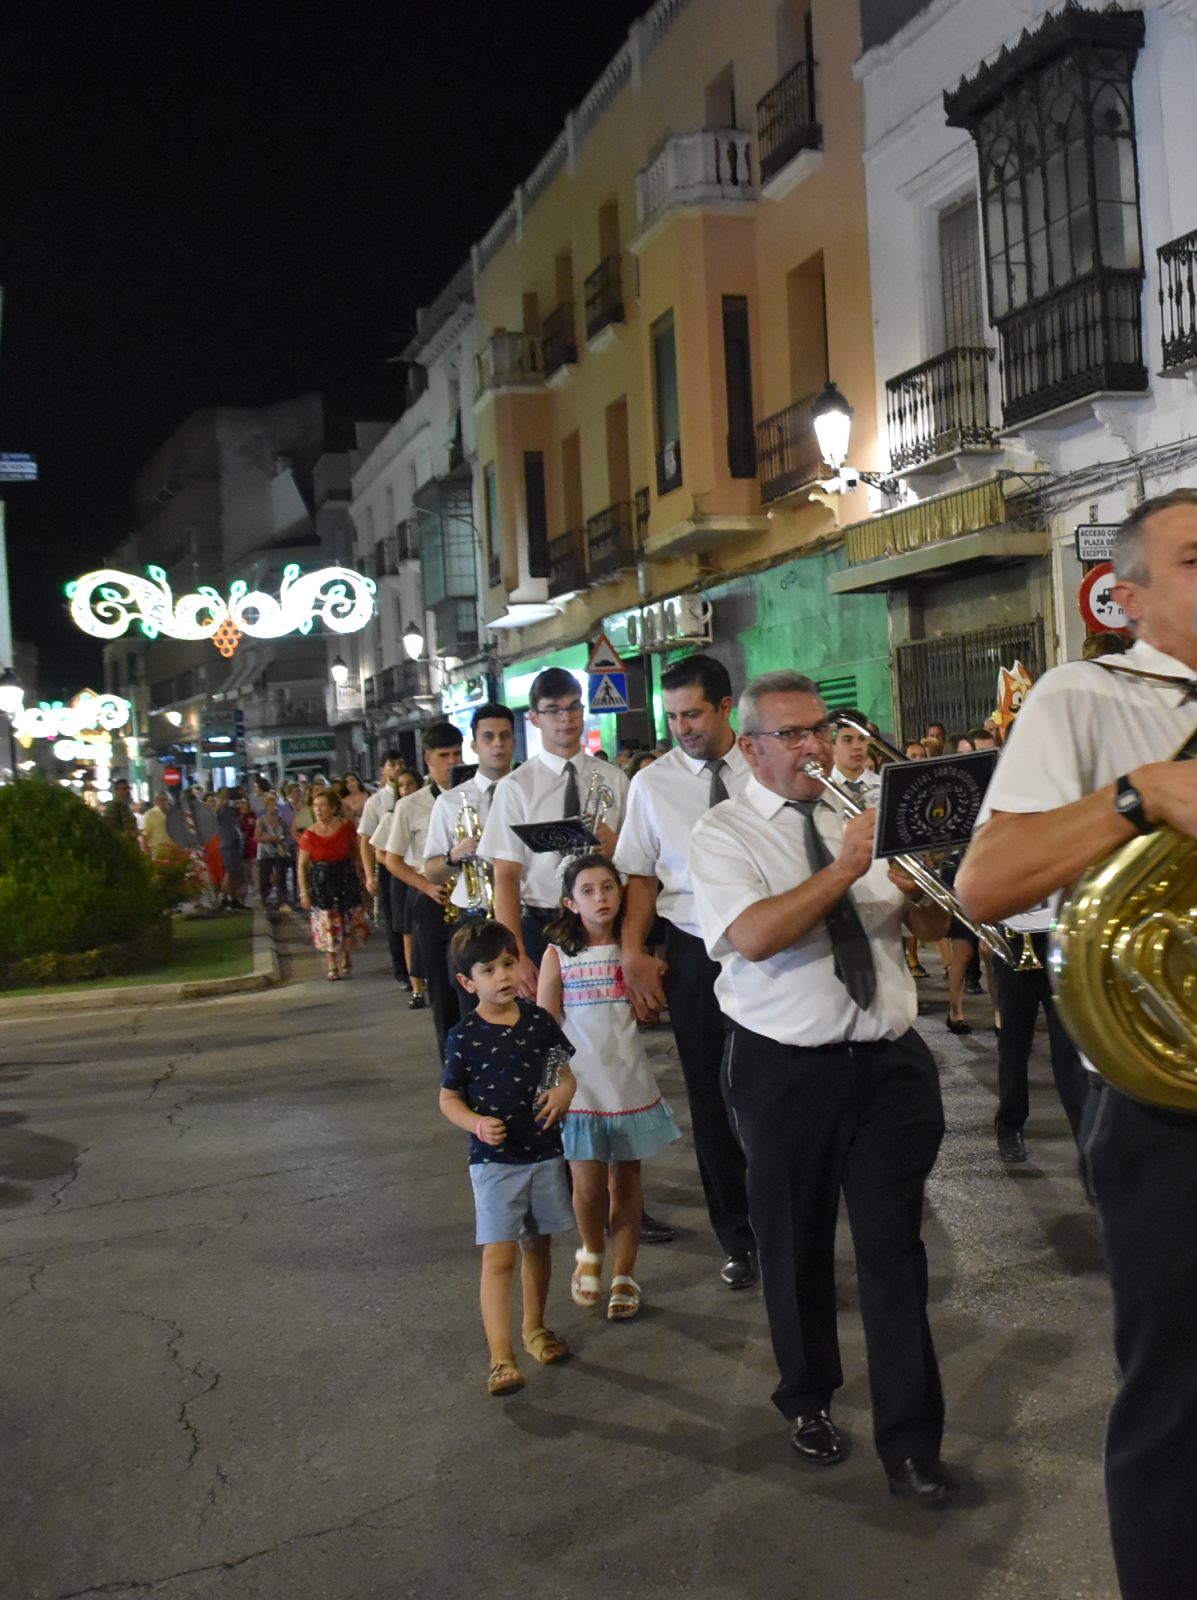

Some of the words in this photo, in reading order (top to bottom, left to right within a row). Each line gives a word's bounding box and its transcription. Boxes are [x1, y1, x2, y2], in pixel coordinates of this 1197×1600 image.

[1080, 529, 1106, 537] ACCESO
[1082, 549, 1108, 557] EXCEPTO
[1107, 606, 1113, 615] 7
